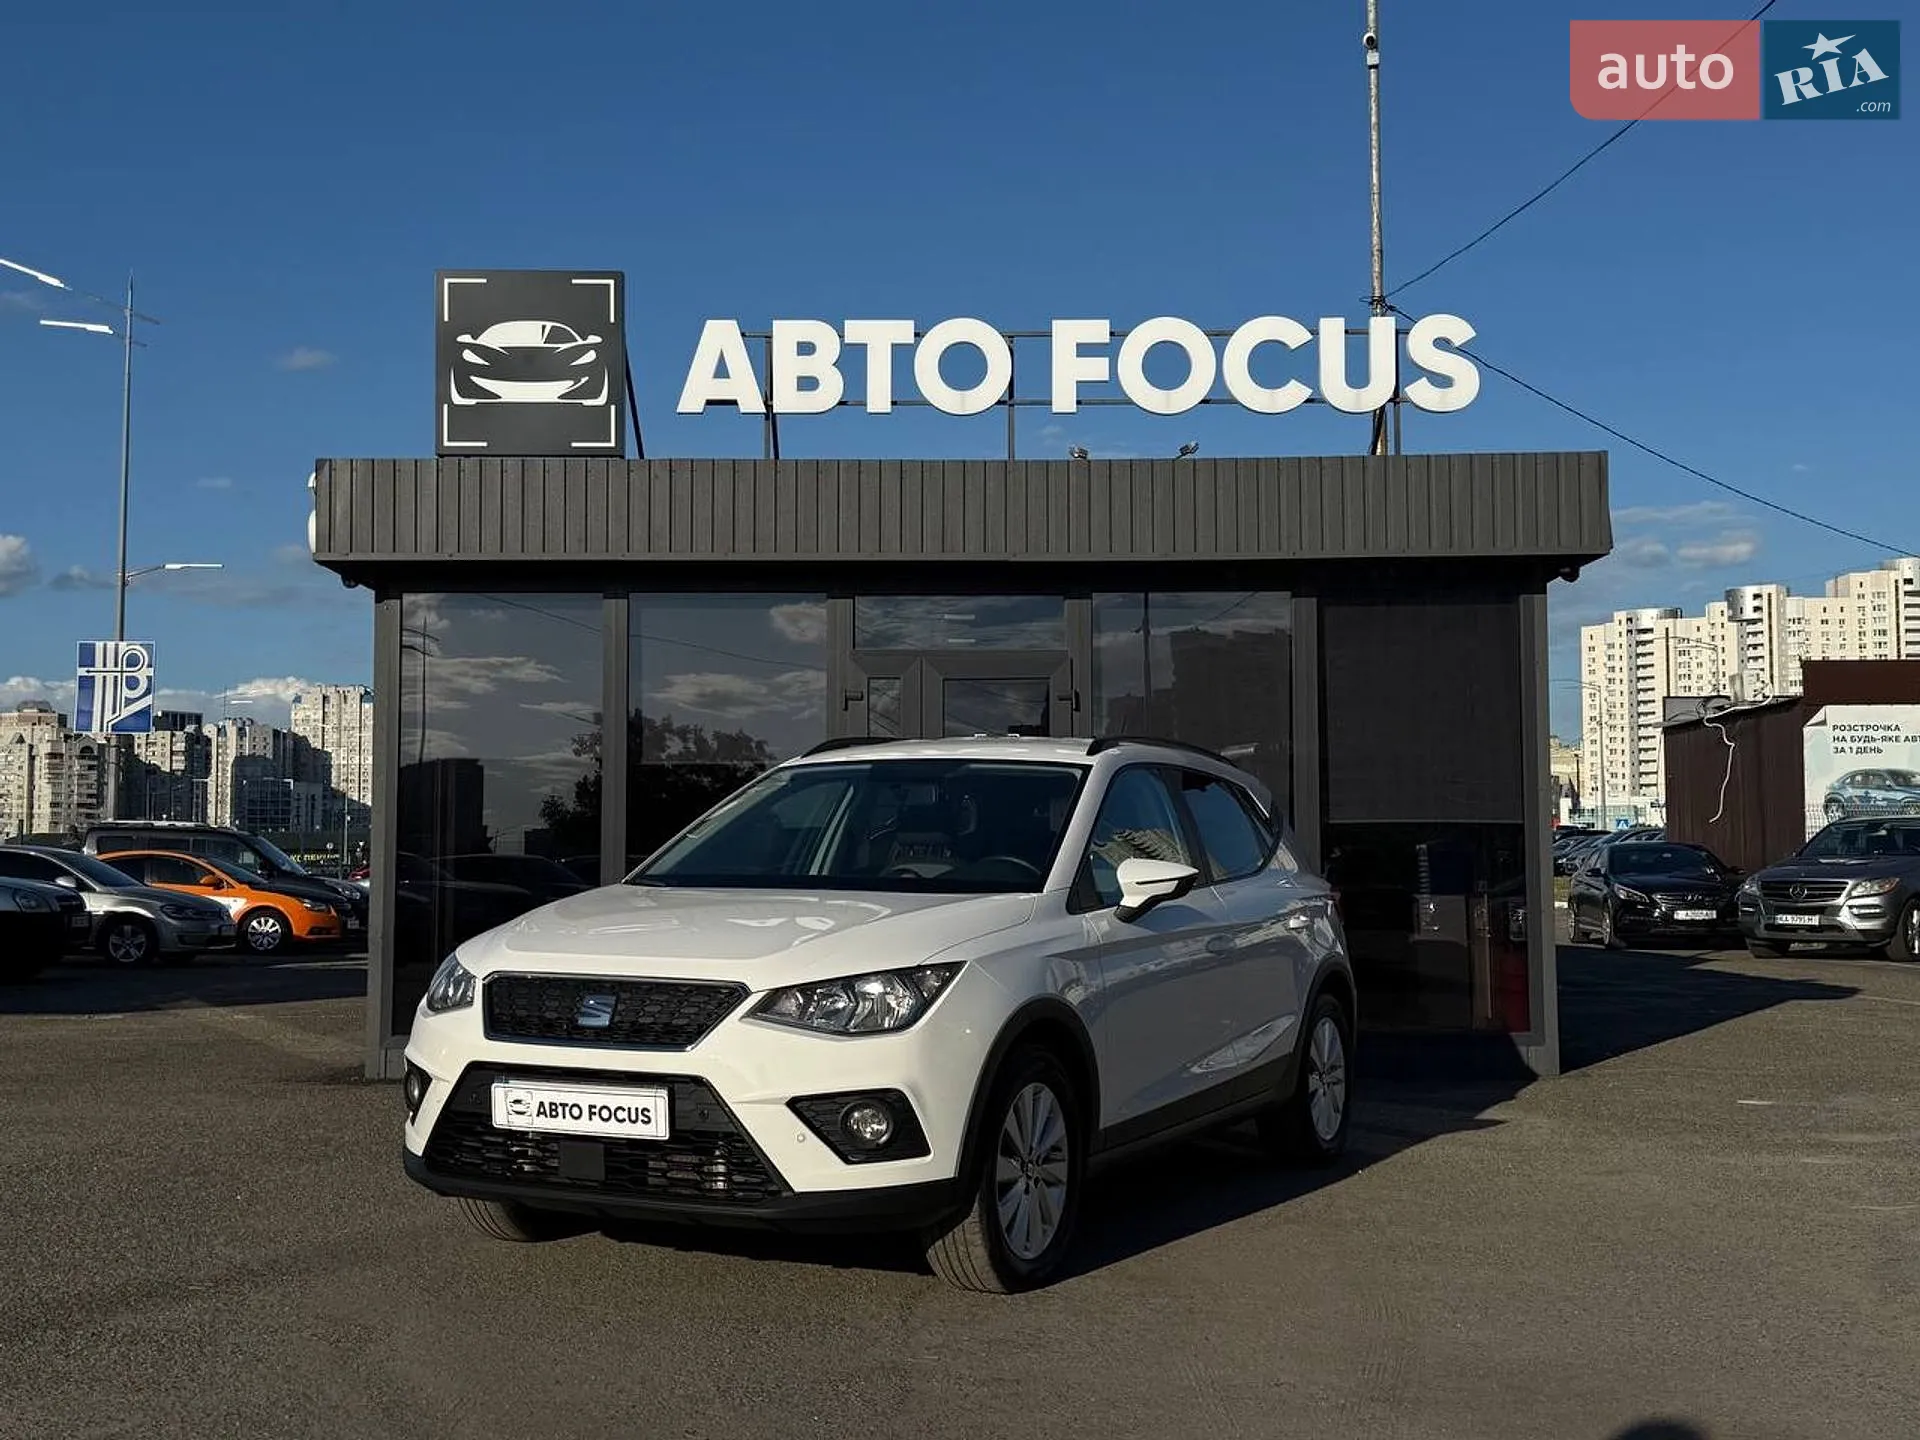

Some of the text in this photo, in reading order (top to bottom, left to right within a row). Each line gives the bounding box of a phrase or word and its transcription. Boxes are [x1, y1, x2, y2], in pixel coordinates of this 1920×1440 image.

[676, 313, 1480, 416] АВТО FOCUS
[1832, 724, 1901, 732] РОЗСТРОЧКА
[1832, 735, 1847, 743] НА
[1850, 735, 1900, 744] БУДЬ-ЯКЕ
[1833, 746, 1847, 754] ЗА
[1855, 746, 1884, 755] ДЕНЬ
[535, 1100, 652, 1125] АВТО FOCUS
